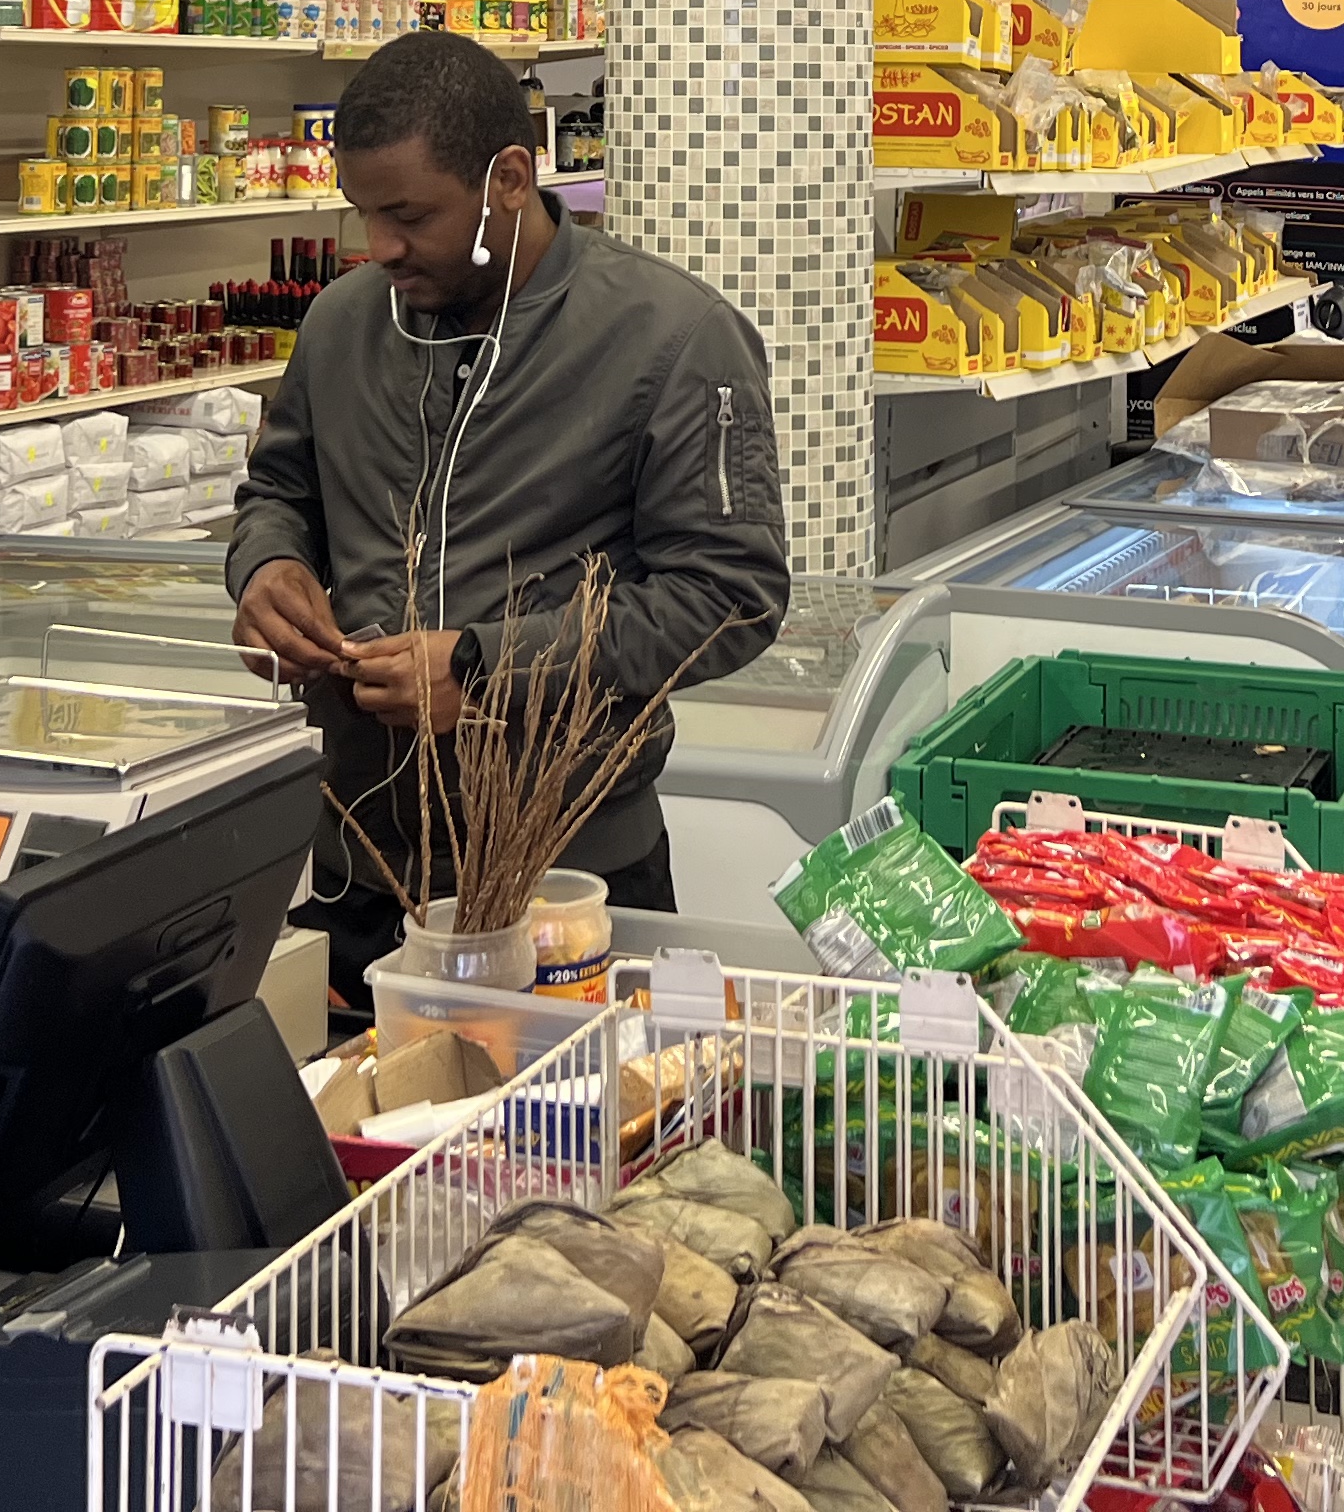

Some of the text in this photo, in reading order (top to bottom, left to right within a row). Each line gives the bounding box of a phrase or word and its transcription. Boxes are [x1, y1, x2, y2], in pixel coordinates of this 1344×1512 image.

[1302, 1, 1342, 13] 30 jours
[872, 101, 954, 127] STAN
[1235, 186, 1264, 197] Appels
[1265, 187, 1296, 198] illimités
[1297, 191, 1314, 199] vers
[1315, 190, 1325, 200] la
[1227, 322, 1258, 335] nclus
[1126, 399, 1154, 413] yca
[546, 968, 579, 984] +20%
